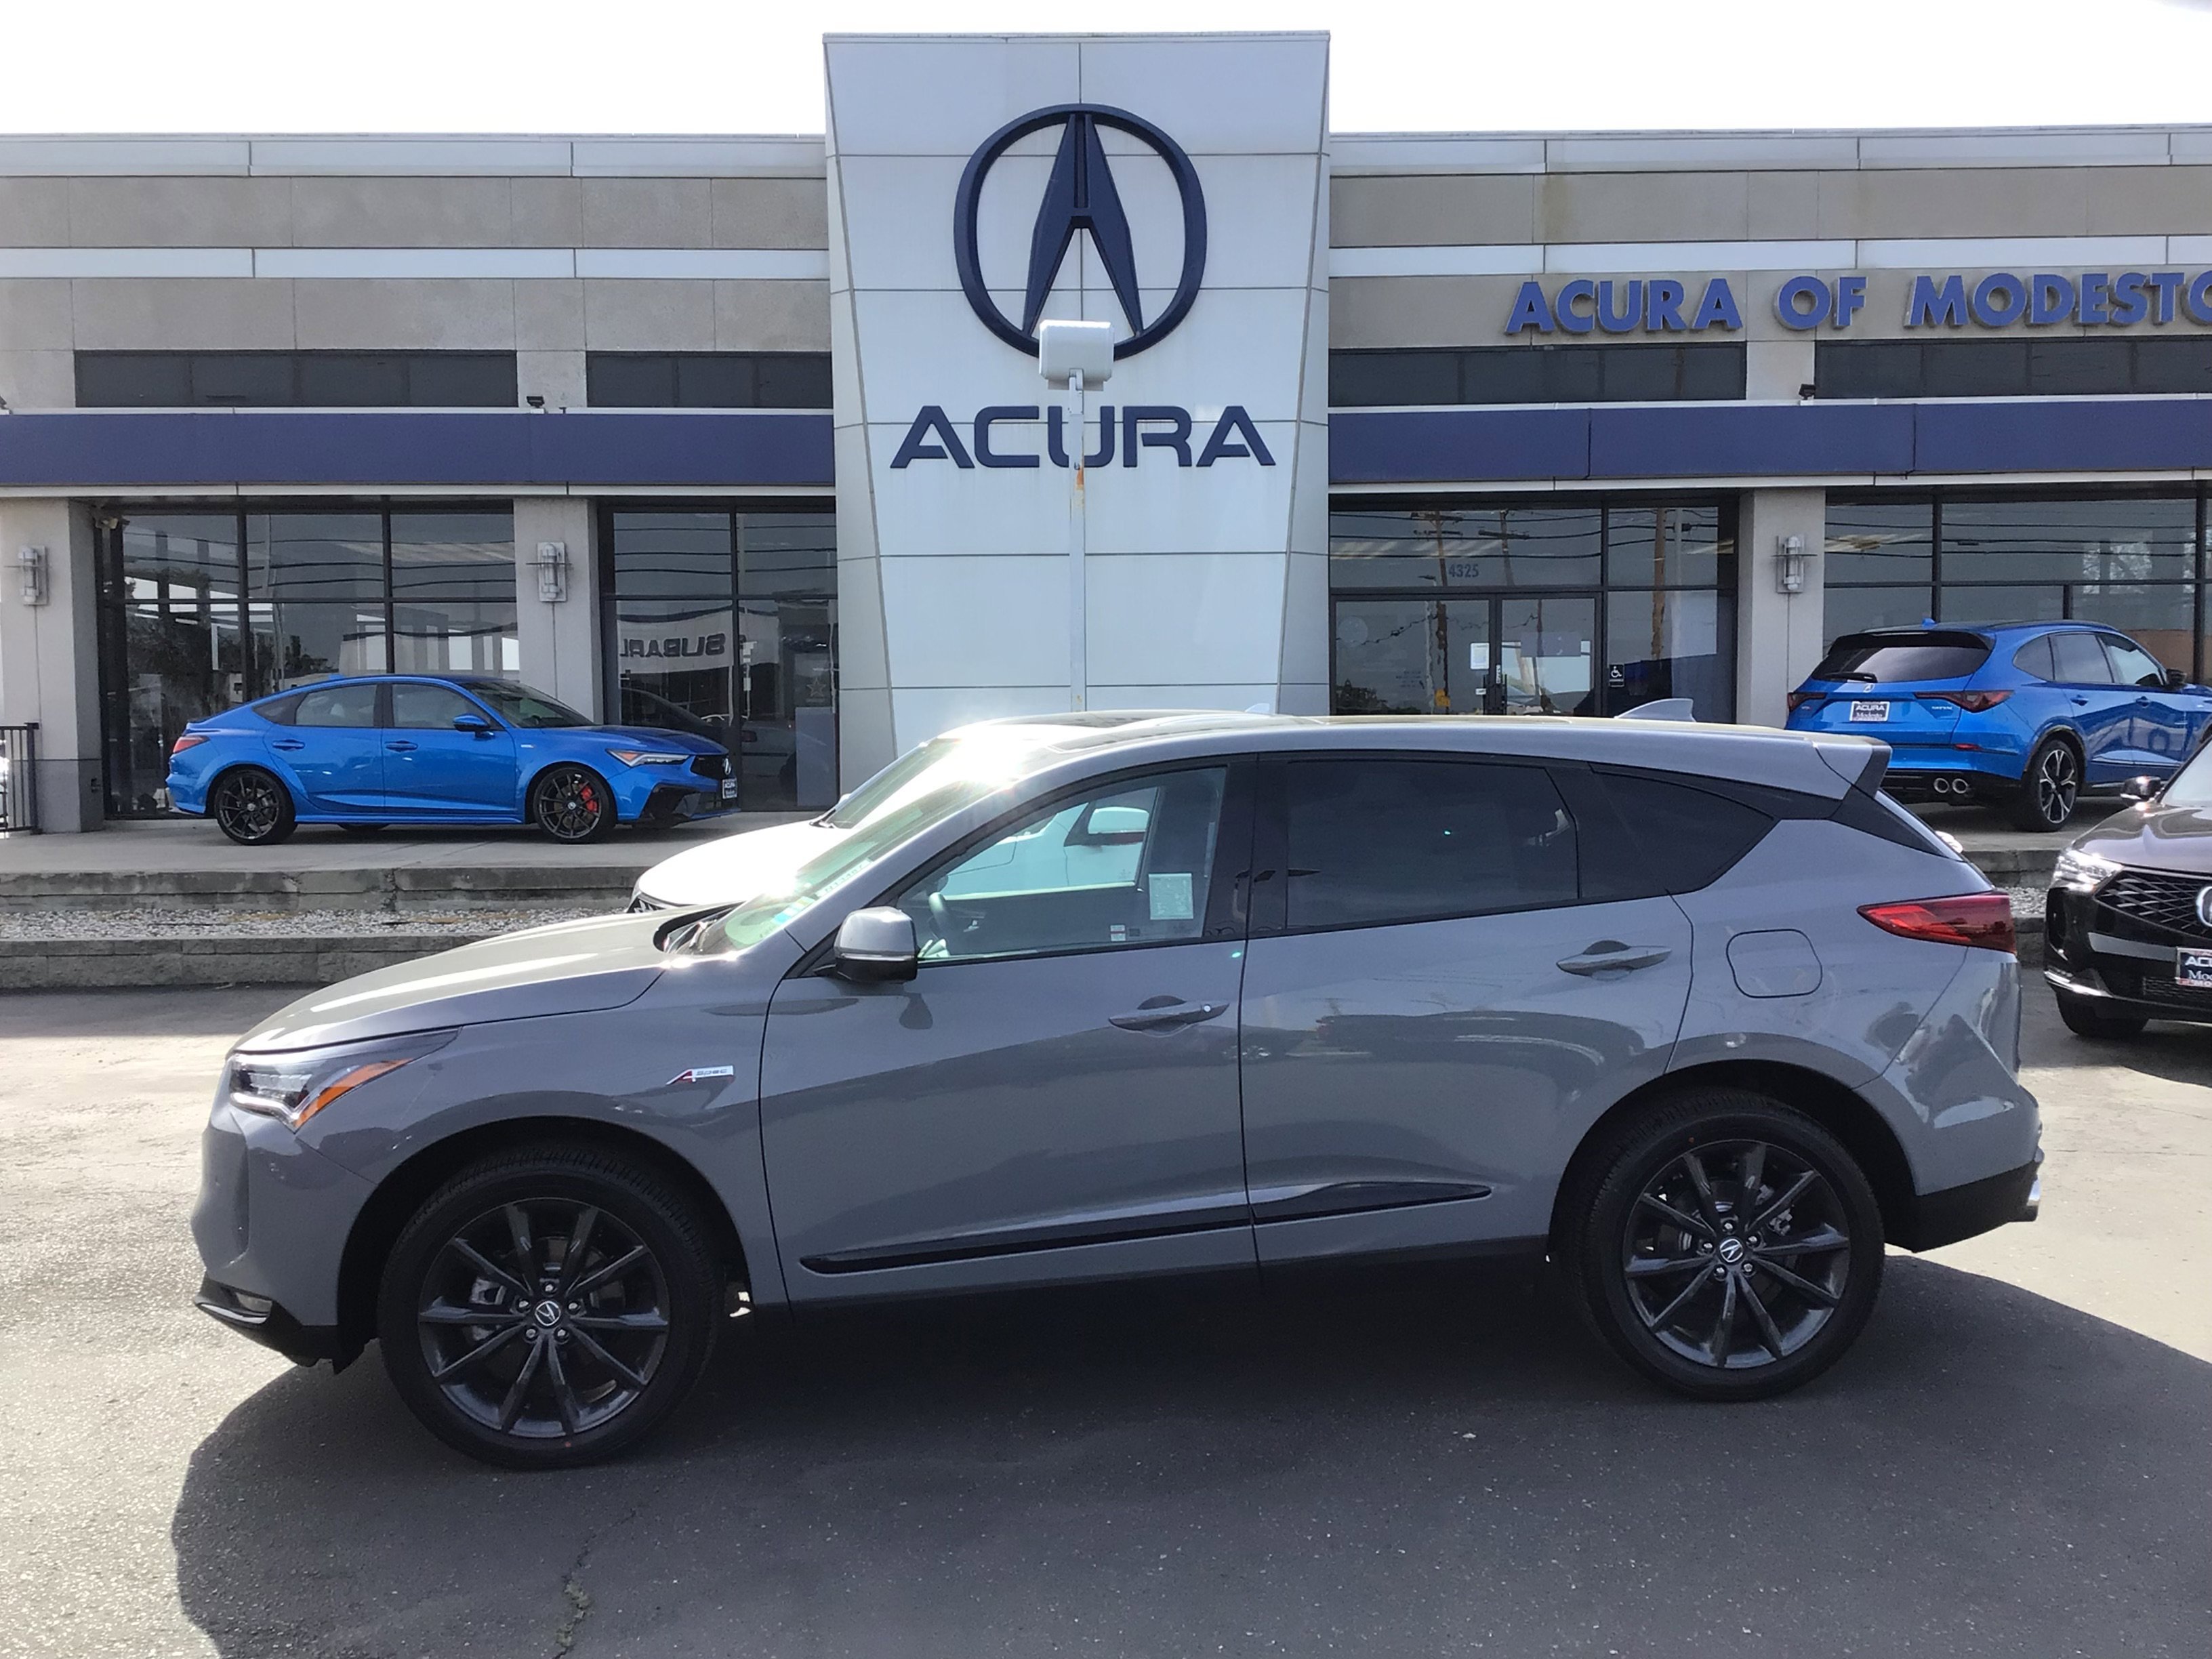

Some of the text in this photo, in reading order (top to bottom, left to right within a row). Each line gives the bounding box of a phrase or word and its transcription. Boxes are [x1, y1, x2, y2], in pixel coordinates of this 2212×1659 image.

[1504, 278, 1744, 334] ACURA
[1774, 275, 1868, 330] OF
[890, 405, 1276, 469] ACURA
[1448, 563, 1479, 577] 4325
